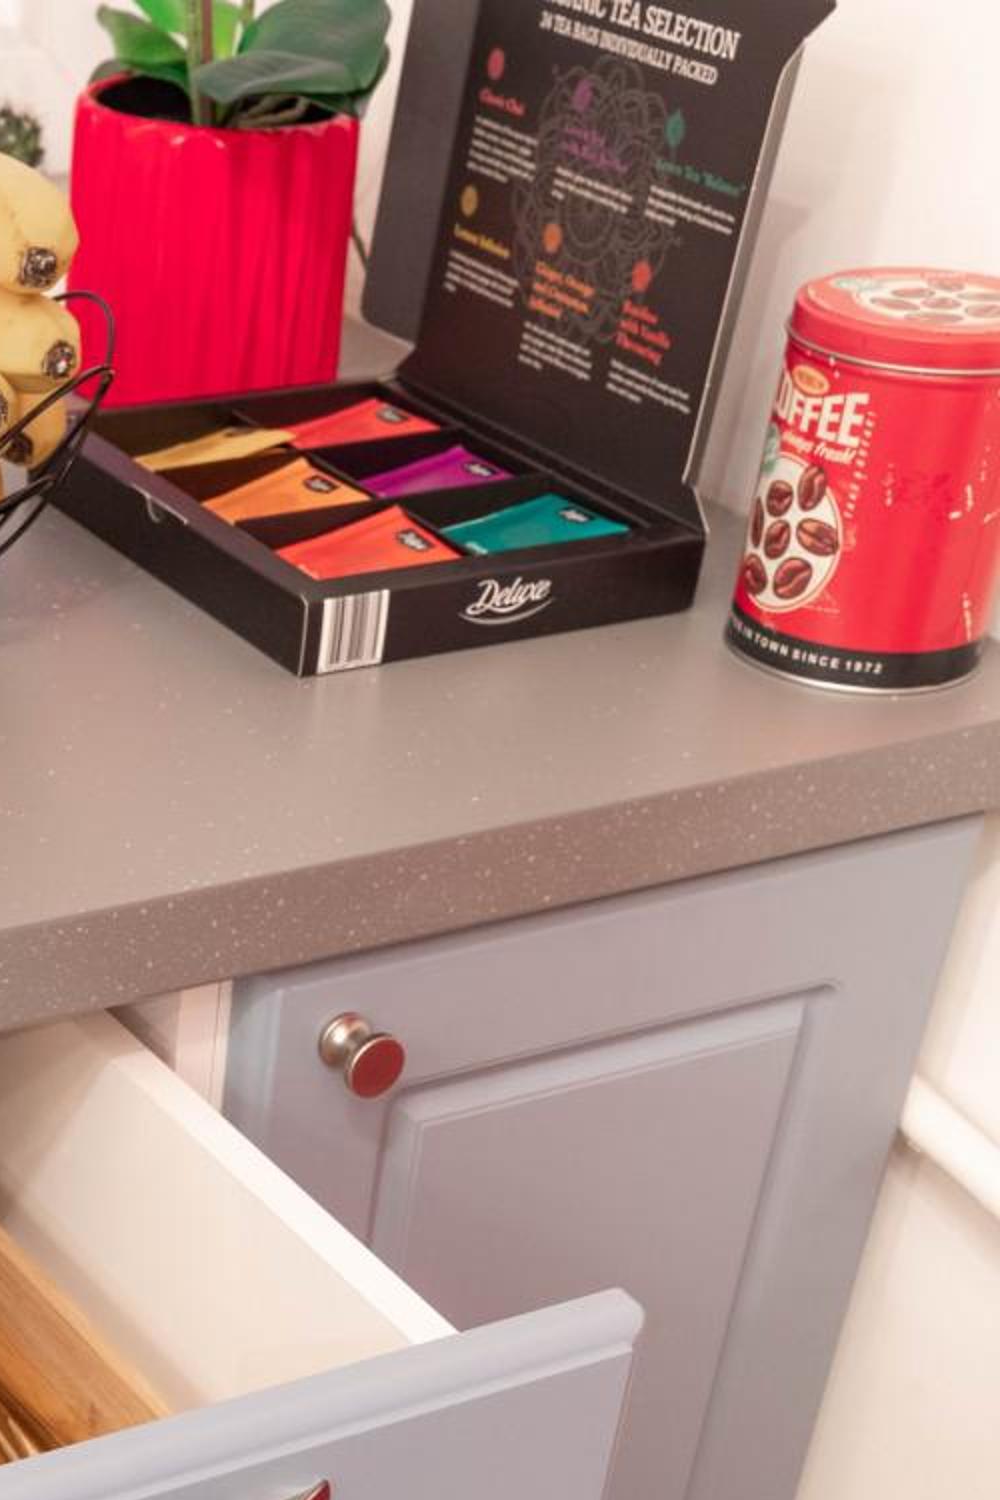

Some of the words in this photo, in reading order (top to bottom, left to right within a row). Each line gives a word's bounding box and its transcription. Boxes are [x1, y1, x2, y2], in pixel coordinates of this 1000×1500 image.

[553, 14, 573, 37] TEA
[599, 30, 675, 71] INDIVIDUALLY
[671, 56, 719, 86] PACKED
[609, 0, 641, 31] TEA
[643, 5, 742, 60] SELECTION
[776, 371, 871, 448] OFFEE
[464, 576, 553, 616] Deluxe
[754, 632, 789, 657] TOWN
[791, 648, 841, 670] SINCE
[844, 660, 884, 675] 1972
